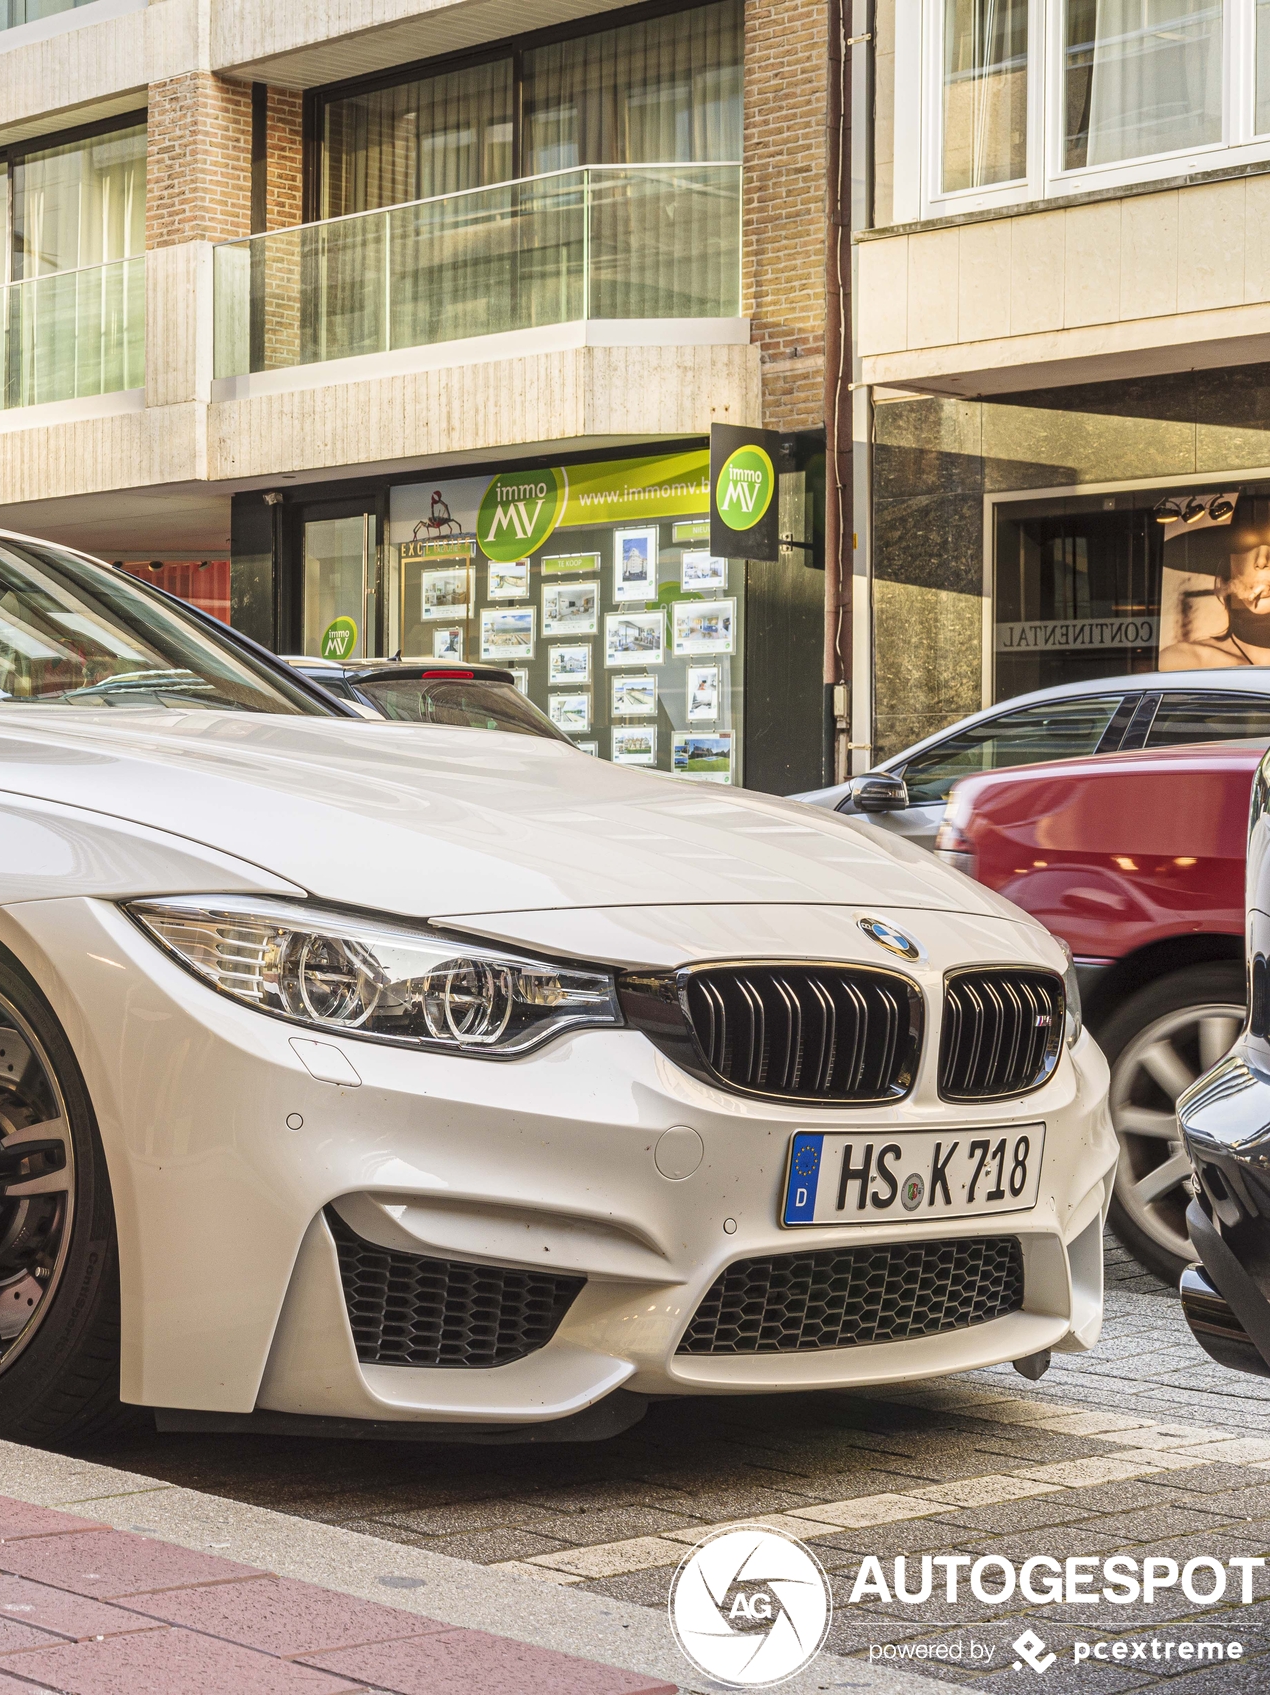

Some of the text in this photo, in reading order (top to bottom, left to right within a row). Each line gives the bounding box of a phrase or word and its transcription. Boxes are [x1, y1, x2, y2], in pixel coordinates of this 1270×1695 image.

[729, 463, 763, 484] immo
[495, 482, 547, 502] immo
[578, 475, 711, 507] www.immomv.b
[720, 480, 762, 513] MV
[483, 498, 546, 542] MV
[400, 536, 472, 557] EXCLUSIEF
[566, 558, 583, 567] KOOP
[328, 629, 350, 639] immo
[324, 637, 349, 656] MV
[836, 1142, 903, 1211] HS
[795, 1188, 808, 1207] D
